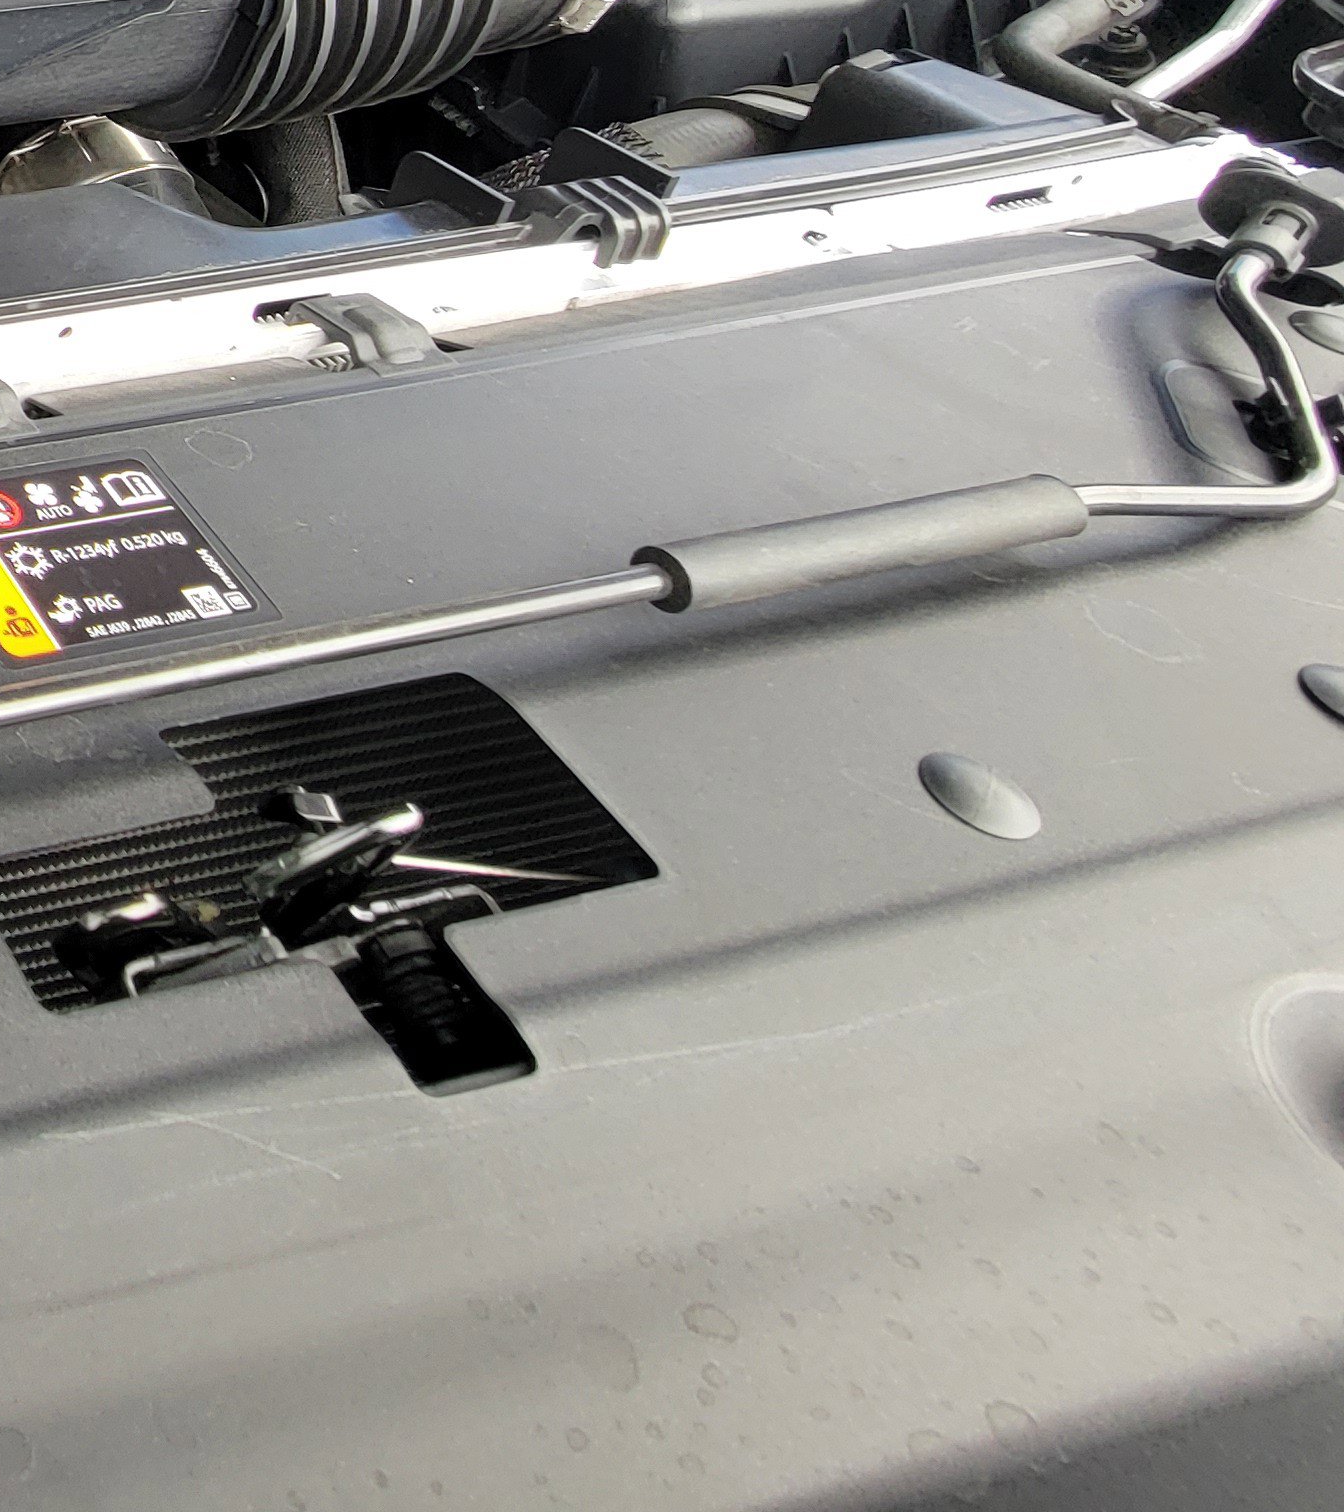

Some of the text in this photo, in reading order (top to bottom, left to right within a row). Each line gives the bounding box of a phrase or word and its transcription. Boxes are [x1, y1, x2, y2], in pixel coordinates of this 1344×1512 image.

[35, 505, 73, 521] AUTO
[49, 530, 188, 564] R-1234yf 0.520 kg
[82, 593, 124, 613] PAG
[85, 625, 109, 638] SAE
